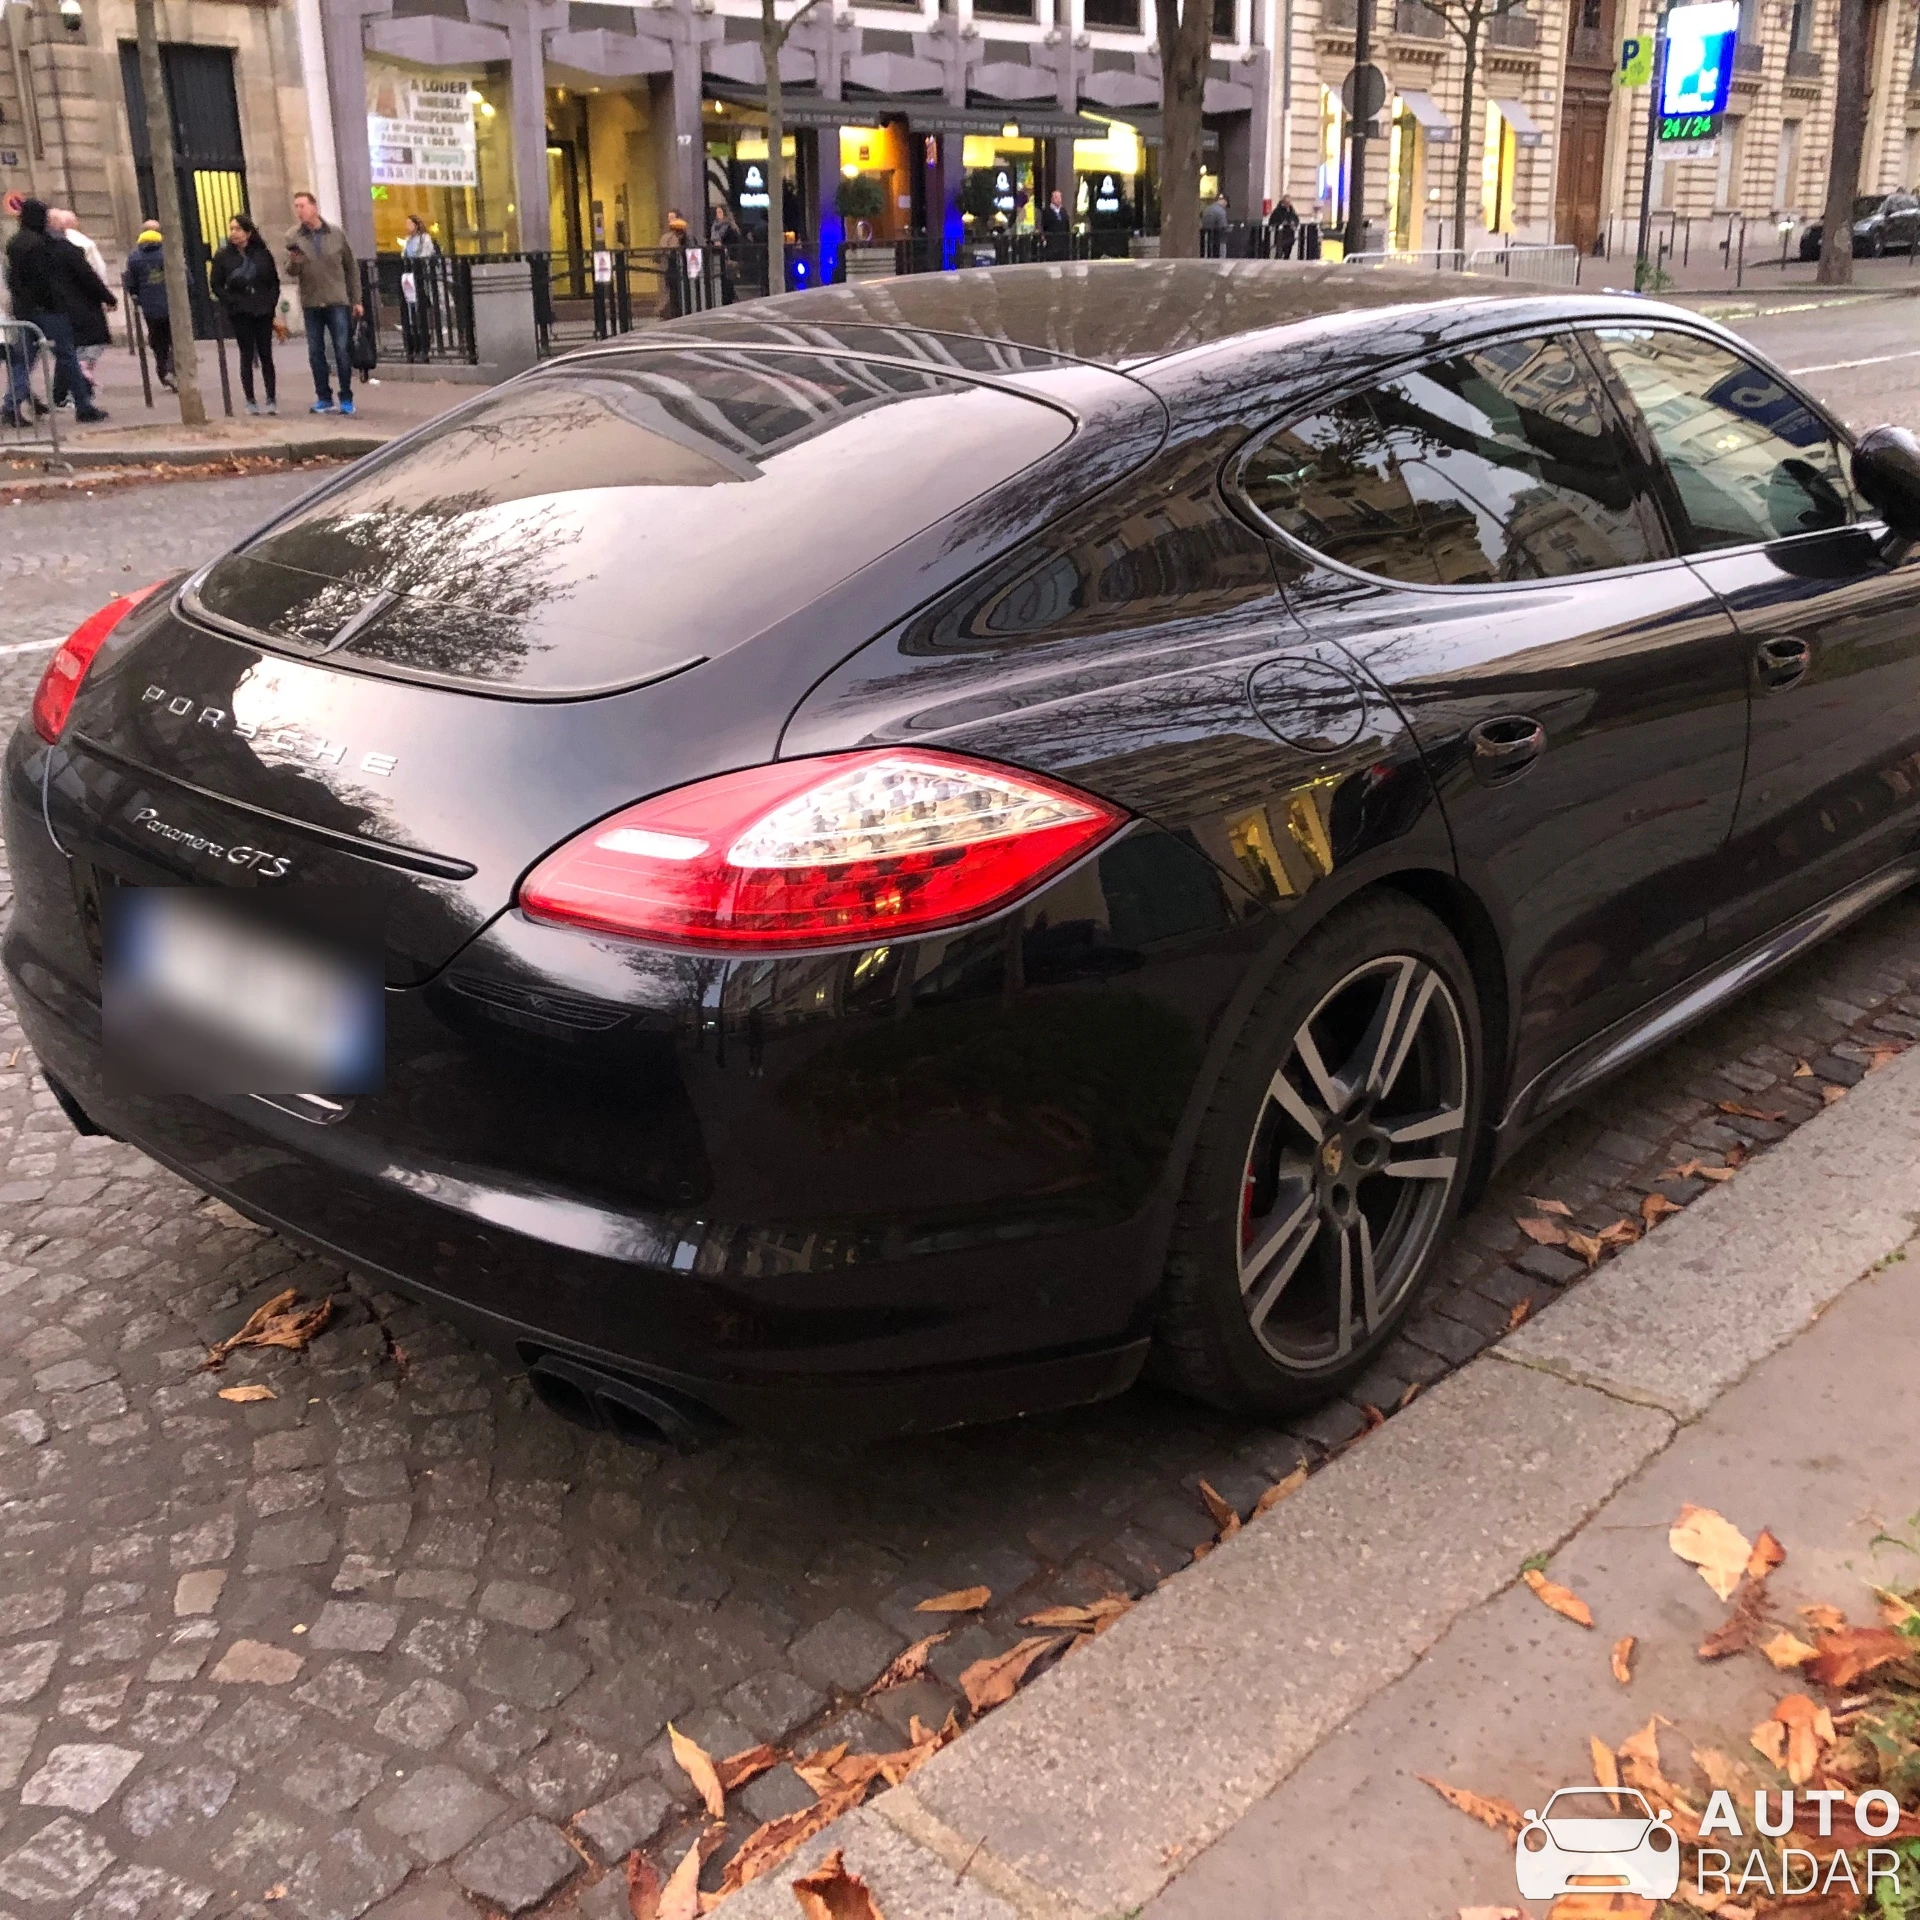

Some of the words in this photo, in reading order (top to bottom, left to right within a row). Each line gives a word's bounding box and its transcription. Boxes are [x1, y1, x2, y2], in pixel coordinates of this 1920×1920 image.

[1621, 39, 1640, 71] P
[422, 80, 467, 95] LOUER
[142, 684, 399, 778] PORSCHE
[132, 807, 224, 858] Panamera
[226, 846, 292, 878] GTS
